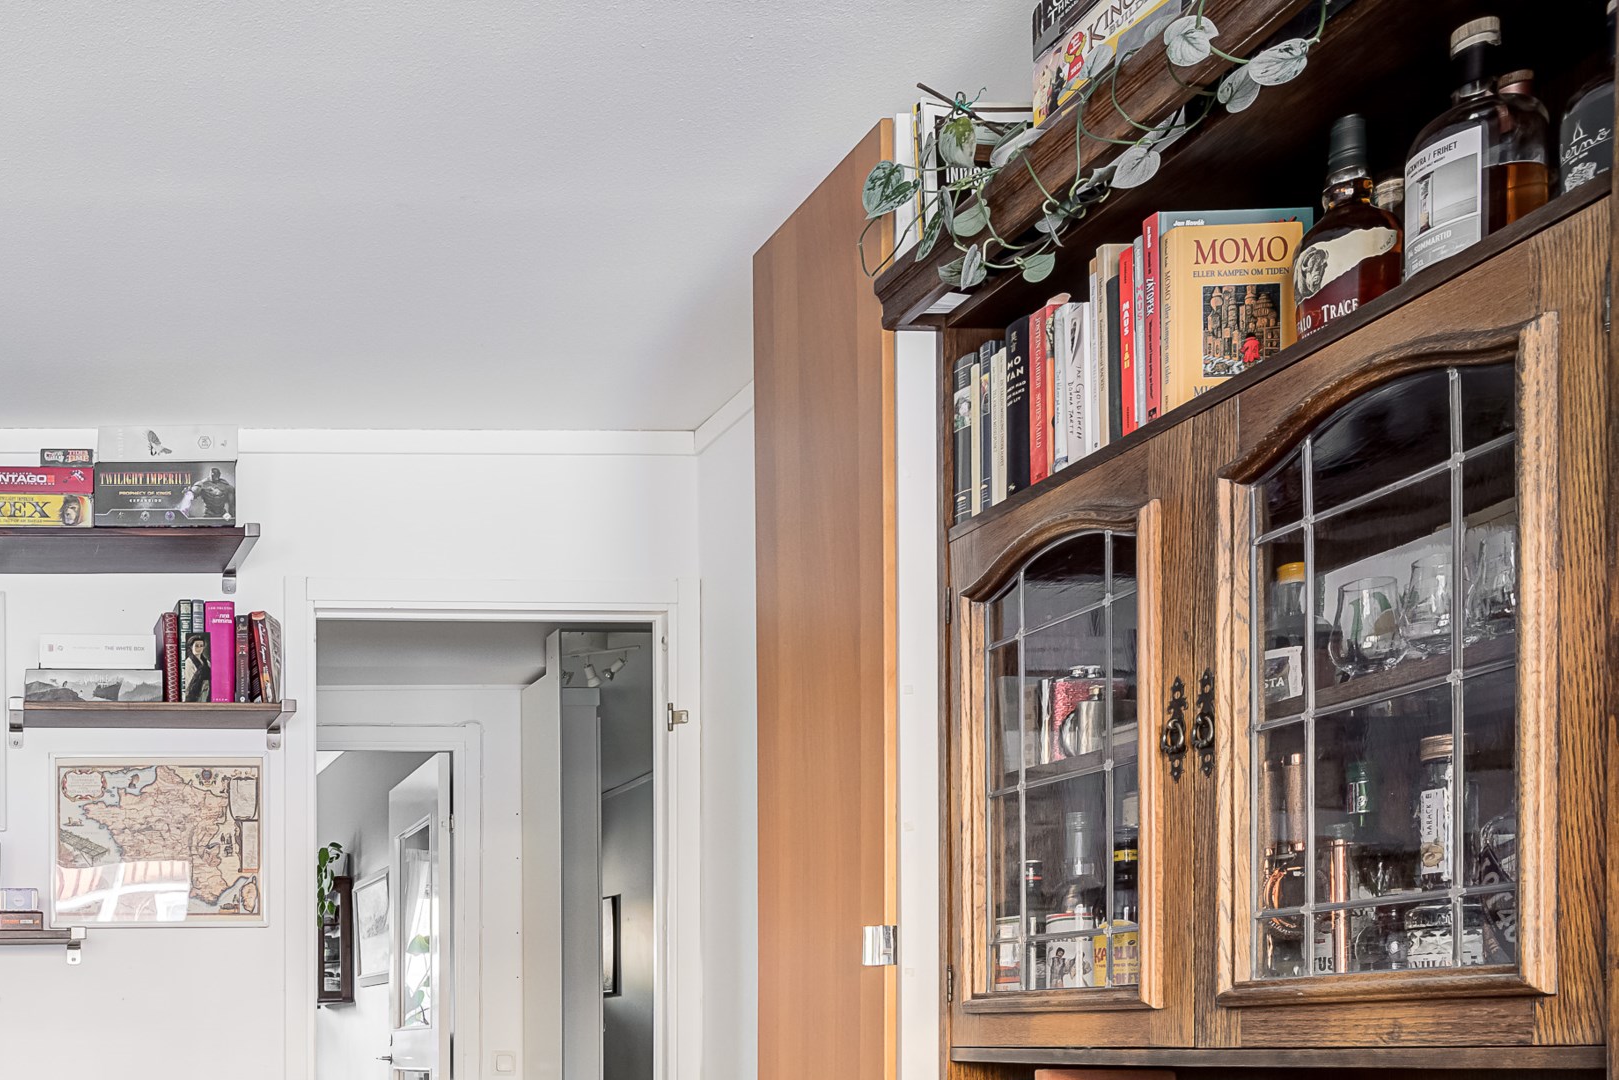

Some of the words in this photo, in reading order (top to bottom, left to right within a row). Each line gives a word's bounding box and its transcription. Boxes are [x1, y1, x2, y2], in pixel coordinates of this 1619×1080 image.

[1432, 141, 1458, 159] FRIHET
[1193, 236, 1289, 266] MOMO
[1193, 269, 1215, 278] ELLER
[1217, 268, 1250, 278] KAMPEN
[1251, 267, 1264, 276] OM
[1265, 266, 1290, 276] TIDEN
[1146, 276, 1155, 318] ZÁTOPEK
[1122, 301, 1130, 336] MAUS
[1163, 320, 1171, 350] kampen
[100, 473, 144, 485] TWILIGHT
[146, 473, 191, 485] IMPERIUM
